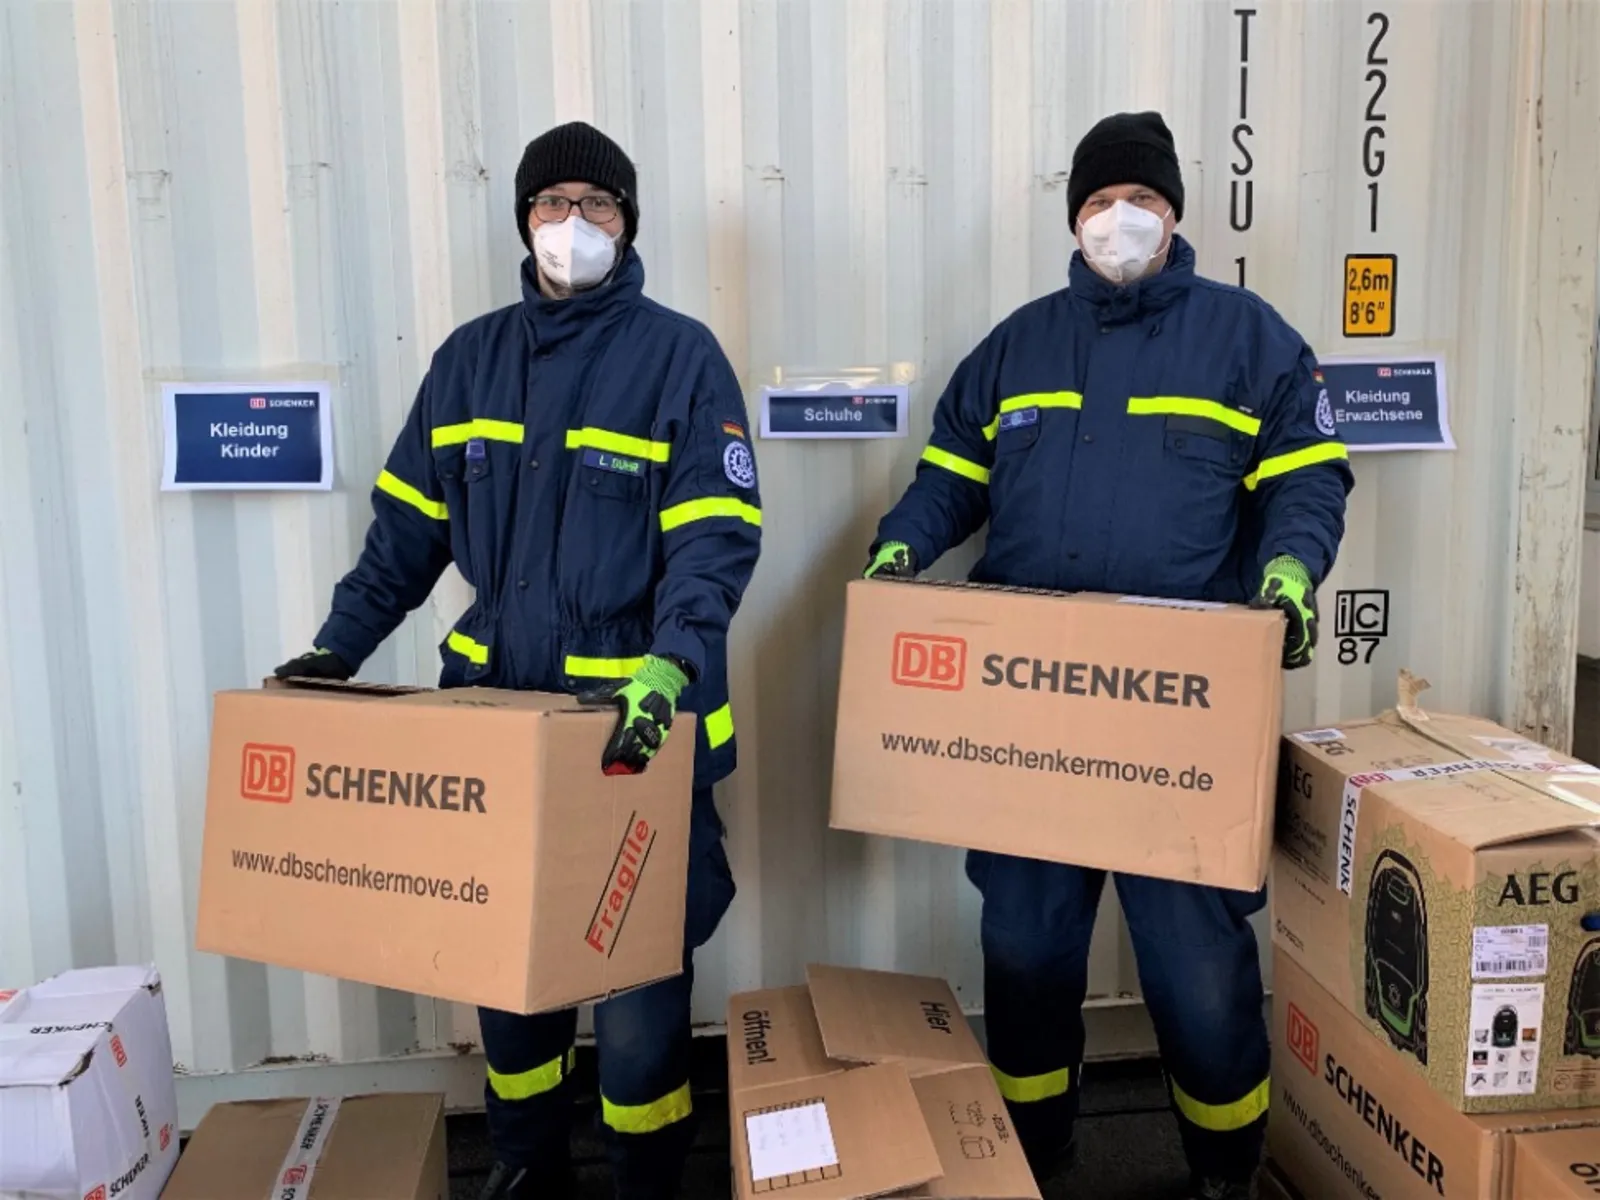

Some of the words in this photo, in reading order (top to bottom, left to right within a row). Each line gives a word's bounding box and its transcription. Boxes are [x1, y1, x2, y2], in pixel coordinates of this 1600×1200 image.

[1362, 12, 1390, 233] 22G1
[1347, 267, 1390, 295] 2,6m
[803, 407, 863, 422] Schuhe
[1345, 389, 1411, 405] Kleidung
[209, 421, 289, 440] Kleidung
[1335, 409, 1424, 423] Erwachsene
[220, 443, 280, 459] Kinder
[1338, 638, 1380, 664] 87
[896, 637, 960, 686] DB
[981, 653, 1211, 709] SCHENKER
[245, 748, 290, 797] DB
[306, 763, 487, 813] SCHENKER
[881, 733, 1214, 792] www.dbschenkermove.de
[232, 850, 490, 904] www.dbschenkermove.de
[587, 819, 650, 953] Fragile
[1498, 871, 1580, 907] AEG
[920, 1001, 952, 1034] Hier
[743, 1010, 776, 1065] öffnen!
[1289, 1007, 1317, 1066] DB
[1324, 1053, 1445, 1197] SCHENKER
